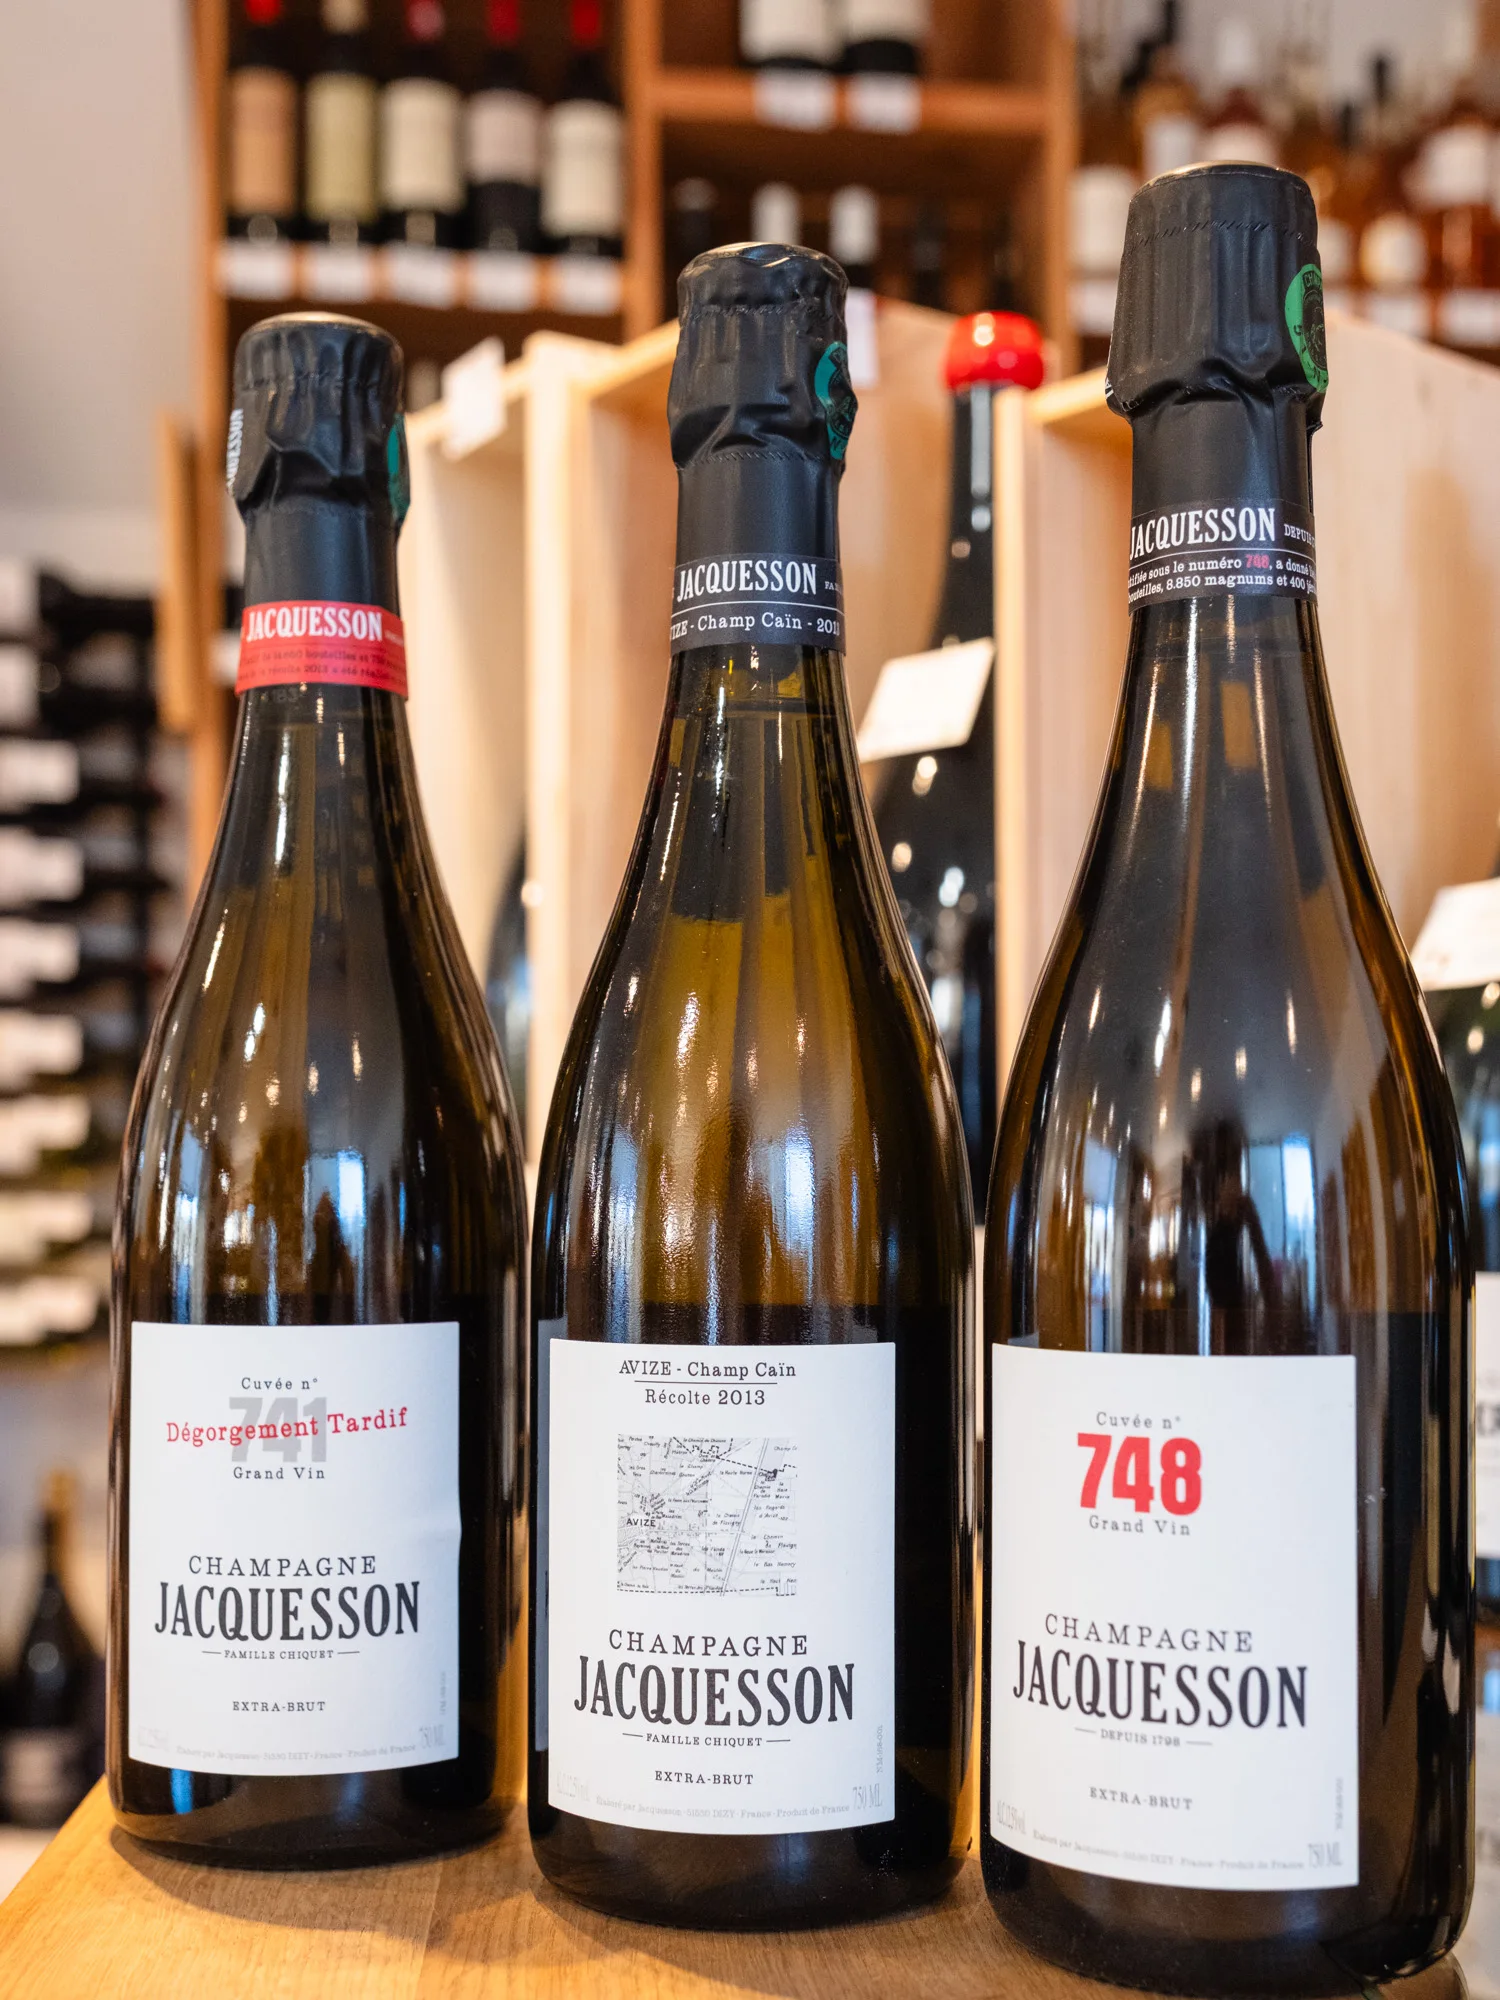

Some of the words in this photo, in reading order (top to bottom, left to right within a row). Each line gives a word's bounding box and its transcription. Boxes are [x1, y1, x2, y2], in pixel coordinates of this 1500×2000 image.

[1129, 507, 1276, 561] JACQUESSON
[1149, 565, 1170, 578] sous
[1173, 560, 1184, 573] le
[1188, 556, 1242, 572] numéro
[1275, 560, 1283, 569] a
[1285, 558, 1309, 576] donné
[677, 560, 817, 602] JACQUESSON
[1166, 574, 1201, 592] 8.850
[1204, 574, 1274, 588] magnums
[1276, 574, 1287, 587] et
[1289, 576, 1306, 591] 400
[246, 605, 384, 642] JACQUESSON
[698, 615, 756, 631] Champ
[761, 612, 802, 630] Caïn
[619, 1360, 672, 1377] AVIZE
[687, 1361, 750, 1381] Champ
[755, 1361, 797, 1378] Caïn
[241, 1377, 294, 1391] Cuvée
[300, 1376, 320, 1391] n°
[645, 1389, 711, 1406] Récolte
[717, 1389, 766, 1406] 2013
[166, 1418, 319, 1448] Dégorgement
[327, 1406, 409, 1434] Tardif
[229, 1396, 328, 1465] 741
[1096, 1411, 1154, 1430] Cuvée
[1162, 1415, 1182, 1430] n°
[233, 1467, 286, 1480] Grand
[293, 1467, 327, 1480] Vin
[1077, 1432, 1203, 1517] 748
[626, 1518, 657, 1528] AVIZE
[1088, 1515, 1145, 1534] Grand
[1154, 1518, 1192, 1536] Vin
[188, 1555, 378, 1578] CHAMPAGNE
[154, 1580, 421, 1643] JACQUESSON
[609, 1629, 808, 1658] CHAMPAGNE
[1044, 1613, 1254, 1654] CHAMPAGNE
[224, 1649, 276, 1661] FAMILLE
[279, 1649, 335, 1661] CHIQUET
[574, 1655, 855, 1728] JACQUESSON
[1012, 1640, 1308, 1730] JACQUESSON
[232, 1700, 327, 1713] EXTRA-BRUT
[646, 1733, 700, 1747] FAMILLE
[704, 1736, 763, 1748] CHIQUET
[1100, 1729, 1147, 1744] DEPUIS
[654, 1770, 754, 1786] EXTRA-BRUT
[1089, 1786, 1193, 1811] EXTRA-BRUT
[623, 1802, 636, 1812] par
[638, 1803, 682, 1817] Jacquesson
[712, 1809, 735, 1818] DIZY
[740, 1809, 771, 1818] France
[775, 1807, 808, 1818] Produit
[809, 1807, 820, 1816] de
[821, 1804, 850, 1815] France
